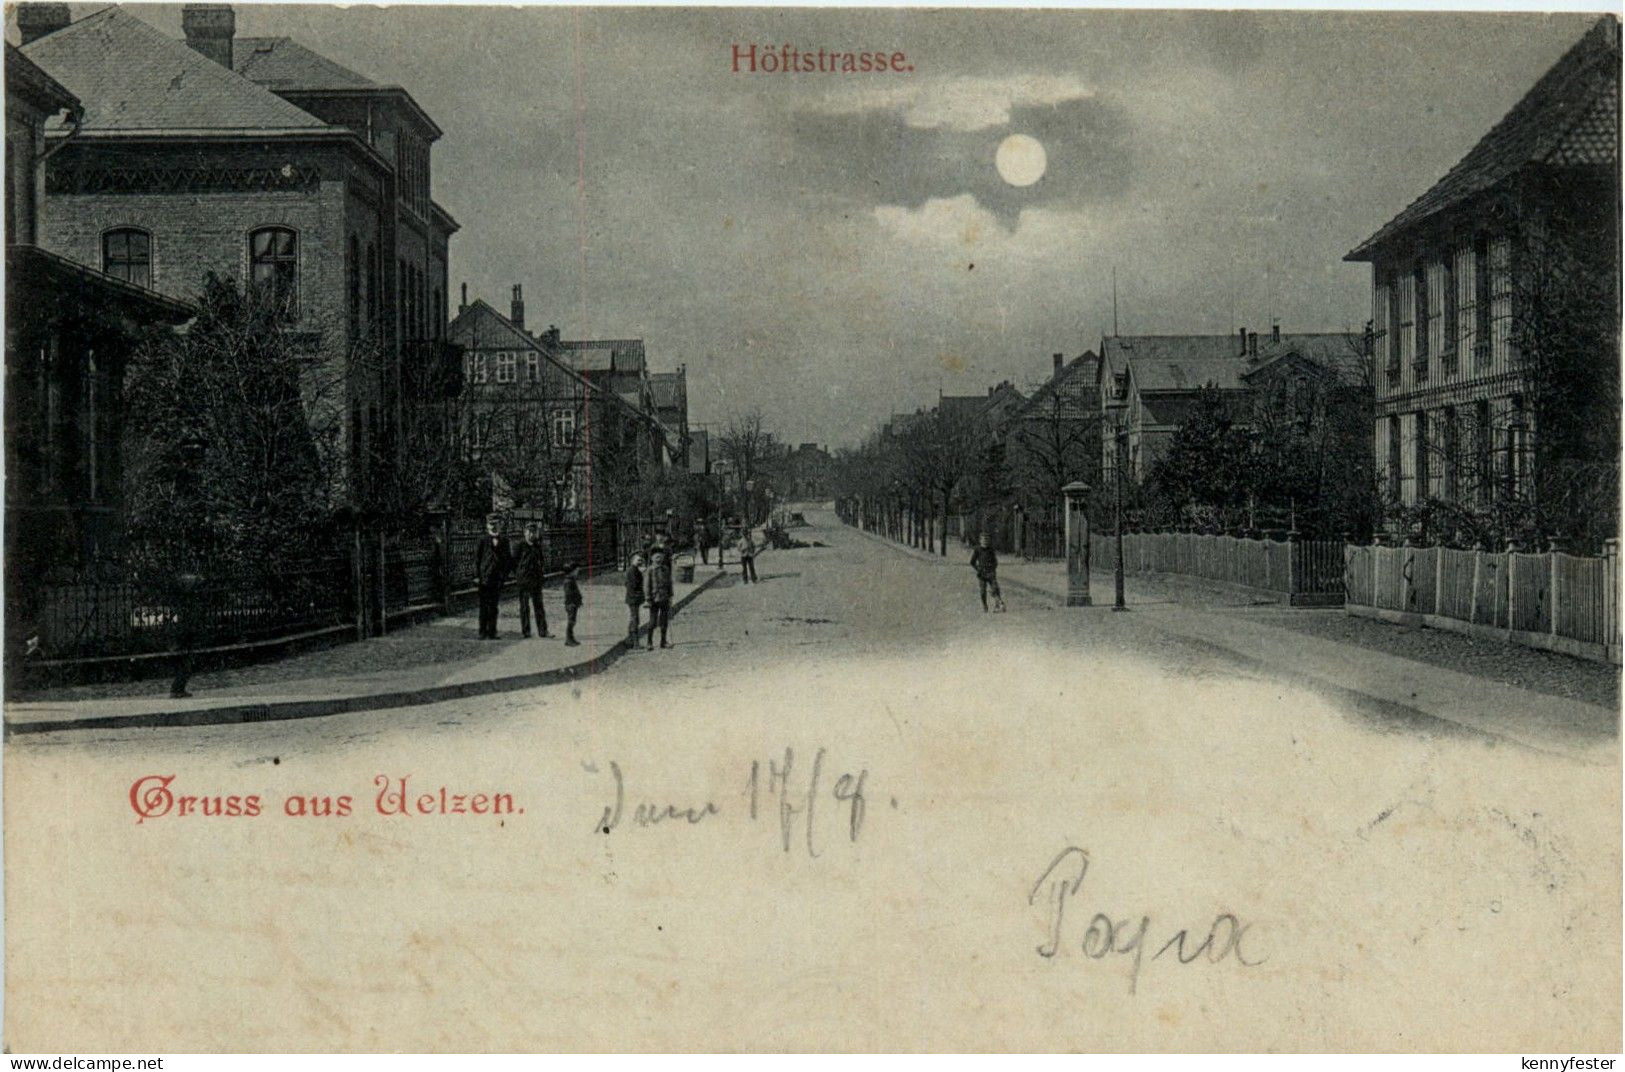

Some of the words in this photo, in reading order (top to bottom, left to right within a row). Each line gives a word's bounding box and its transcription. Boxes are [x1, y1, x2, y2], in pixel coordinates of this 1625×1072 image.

[731, 43, 915, 73] Höftstrasse.
[129, 774, 262, 824] Gruss
[283, 795, 354, 817] aus
[373, 774, 525, 817] Uelzen.
